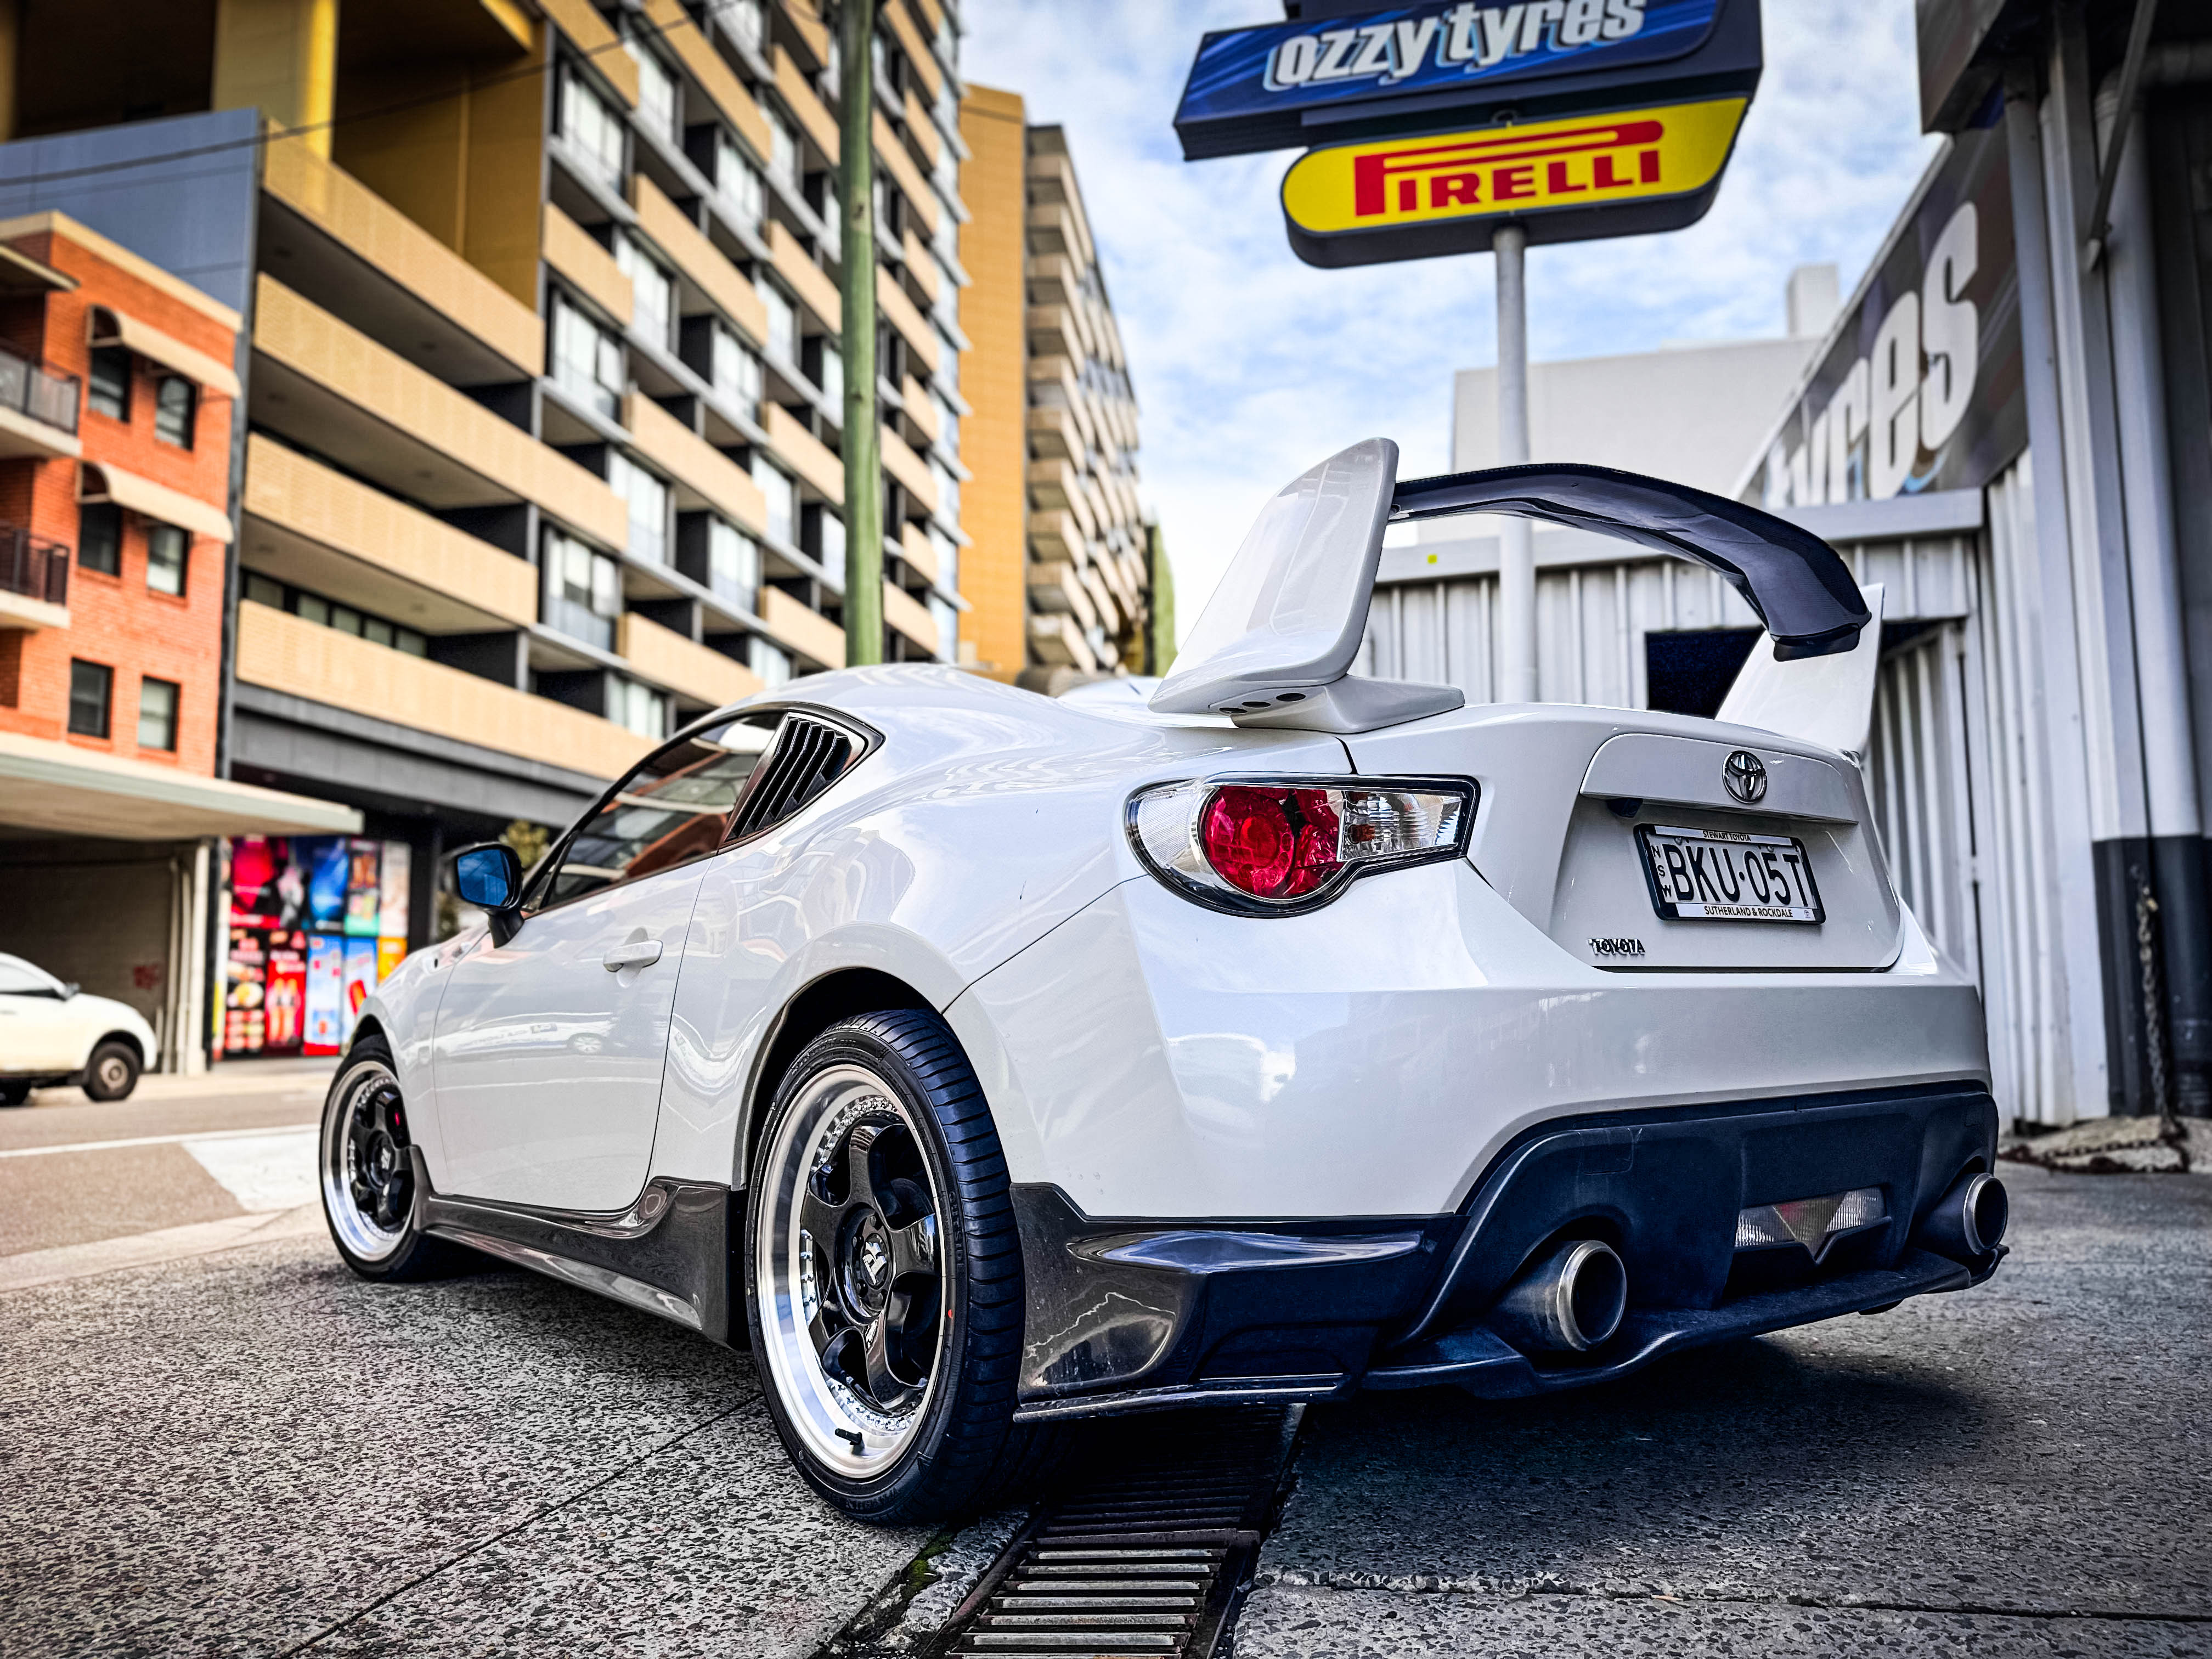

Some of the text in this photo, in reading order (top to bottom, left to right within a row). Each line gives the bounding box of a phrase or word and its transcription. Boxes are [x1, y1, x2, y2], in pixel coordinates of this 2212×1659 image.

[1264, 16, 1440, 90] ozzy
[1354, 120, 1664, 217] PIRELLI
[1702, 831, 1752, 842] STEWART TOYOTA
[1704, 906, 1793, 918] SUTHERLAND & ROCKDALE
[1588, 938, 1646, 956] TOYOTA
